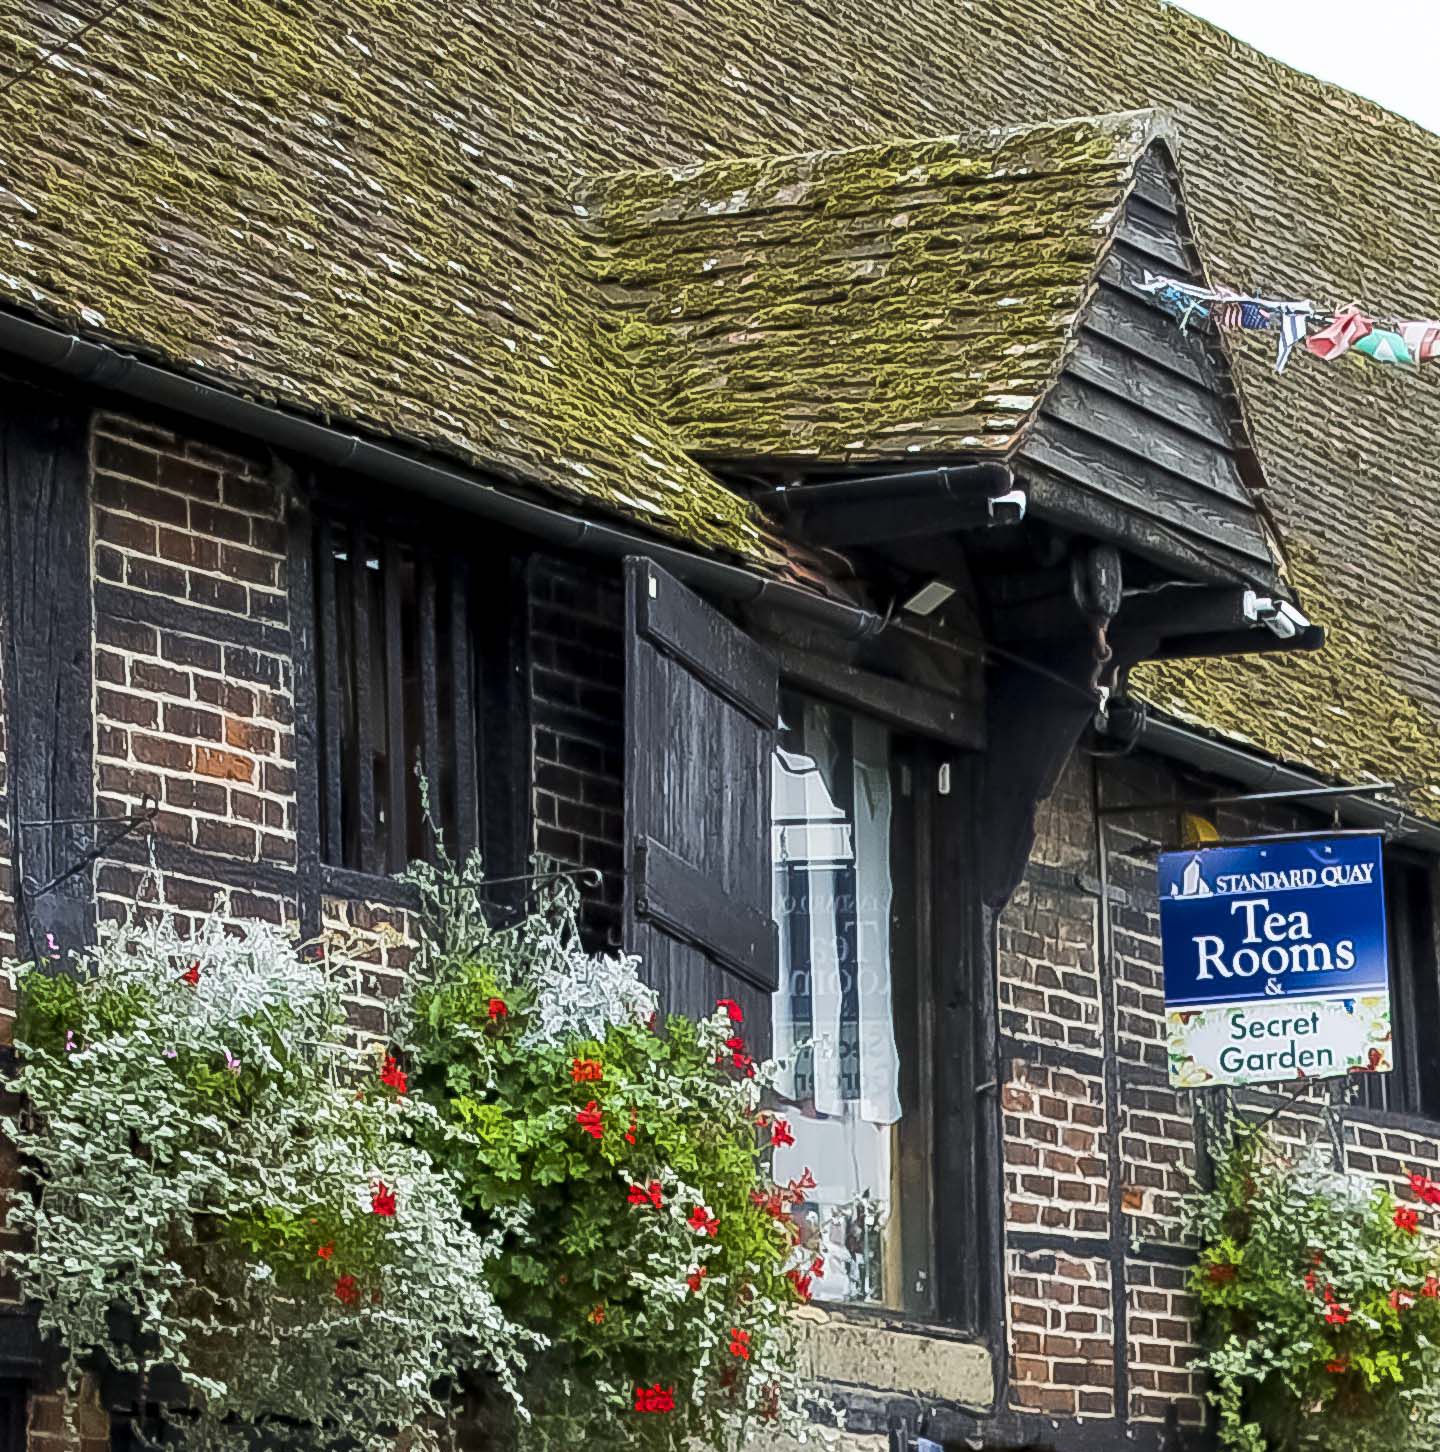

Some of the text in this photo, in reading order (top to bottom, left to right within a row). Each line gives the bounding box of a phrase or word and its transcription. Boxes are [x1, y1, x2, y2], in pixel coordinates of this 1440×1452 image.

[1216, 863, 1374, 893] STANDARD QUAY
[1230, 899, 1312, 944] Tea
[1192, 936, 1355, 980] Rooms
[1265, 977, 1285, 995] &
[1231, 1012, 1320, 1040] Secret
[1219, 1040, 1333, 1073] Garden
